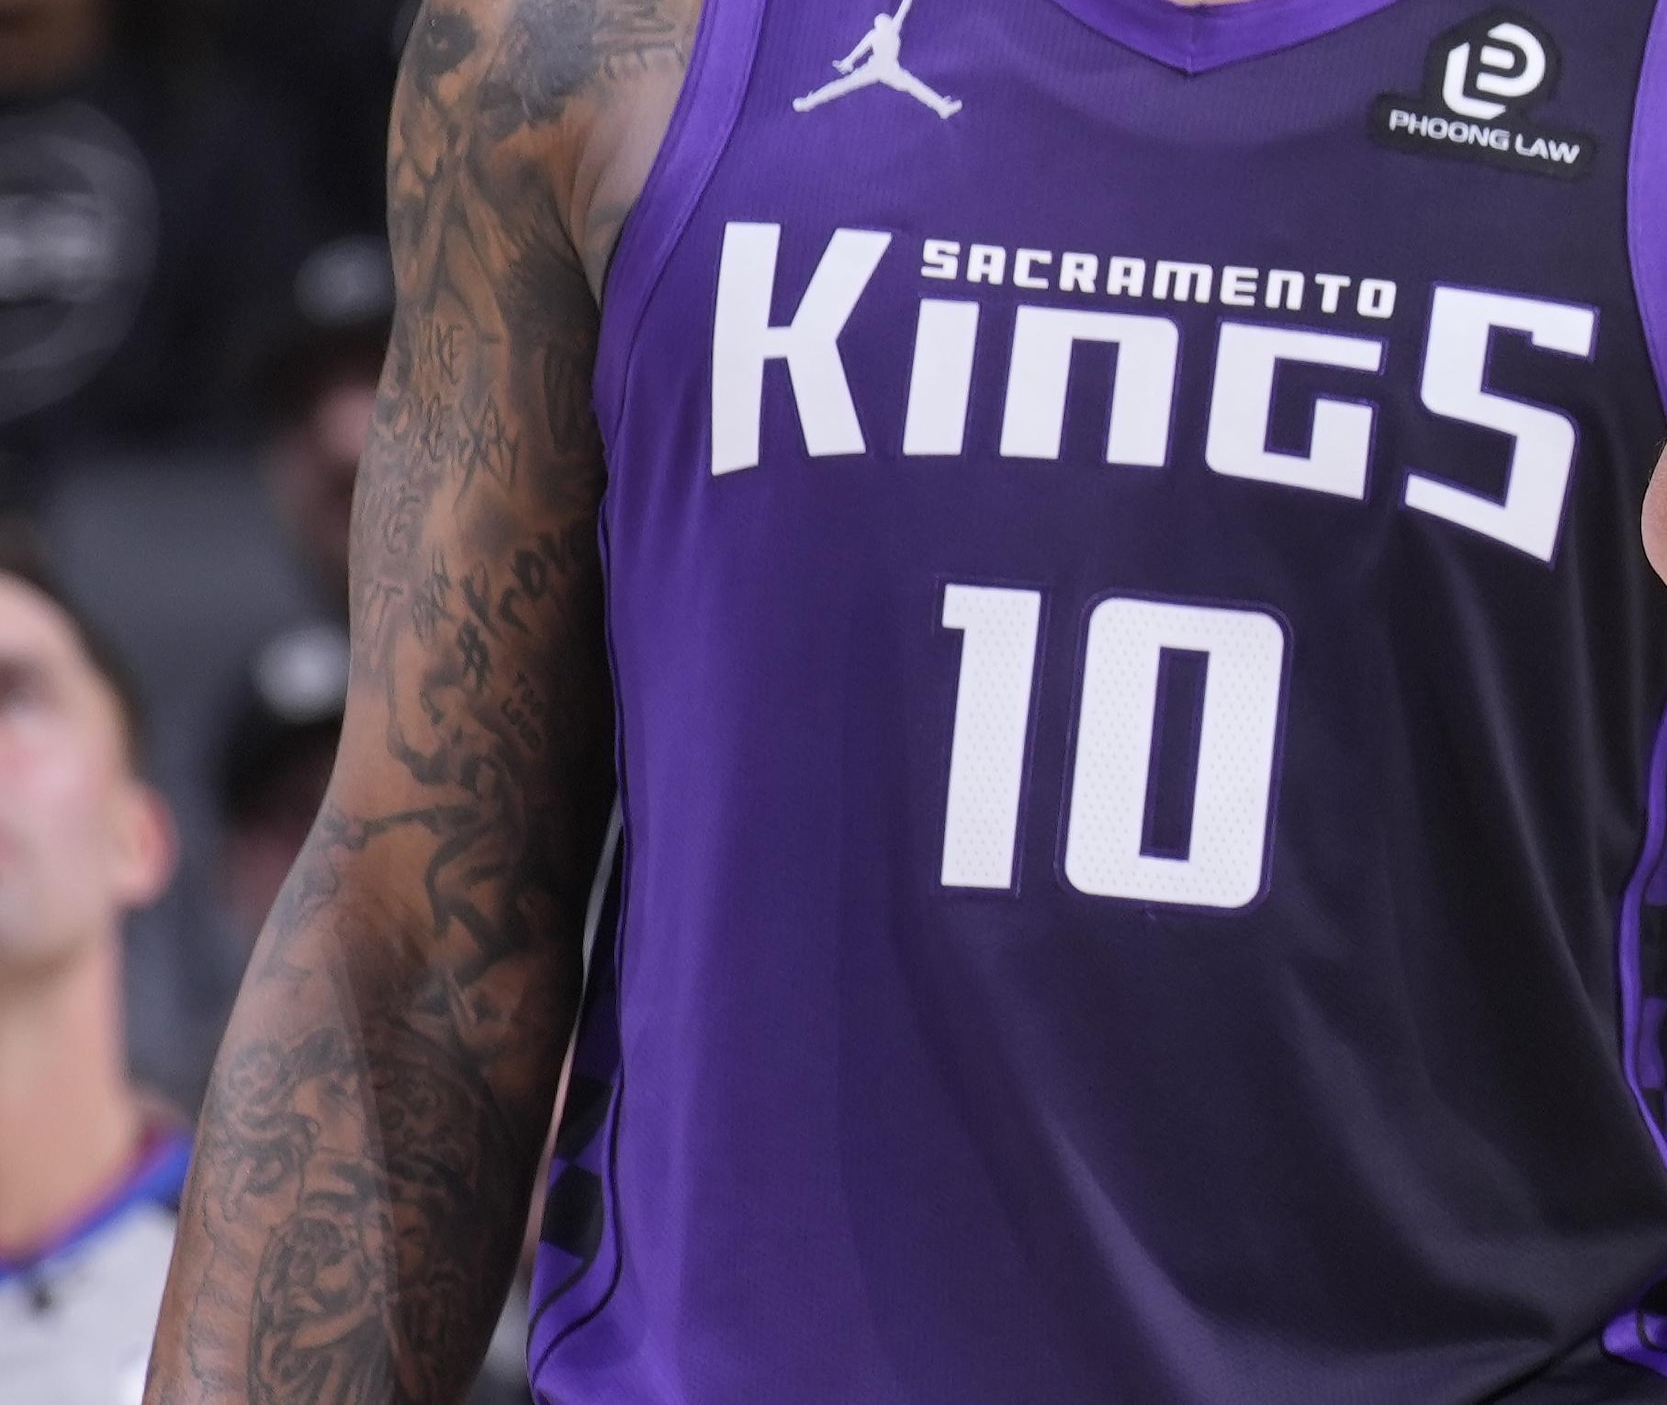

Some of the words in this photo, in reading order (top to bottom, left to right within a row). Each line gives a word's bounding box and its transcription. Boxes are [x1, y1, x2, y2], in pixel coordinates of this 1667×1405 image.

[1388, 108, 1511, 152] PHOONG
[1514, 132, 1581, 165] LAW
[919, 237, 1398, 320] SACRAMENTO
[710, 221, 1600, 565] KINGS
[940, 582, 1286, 910] 10
